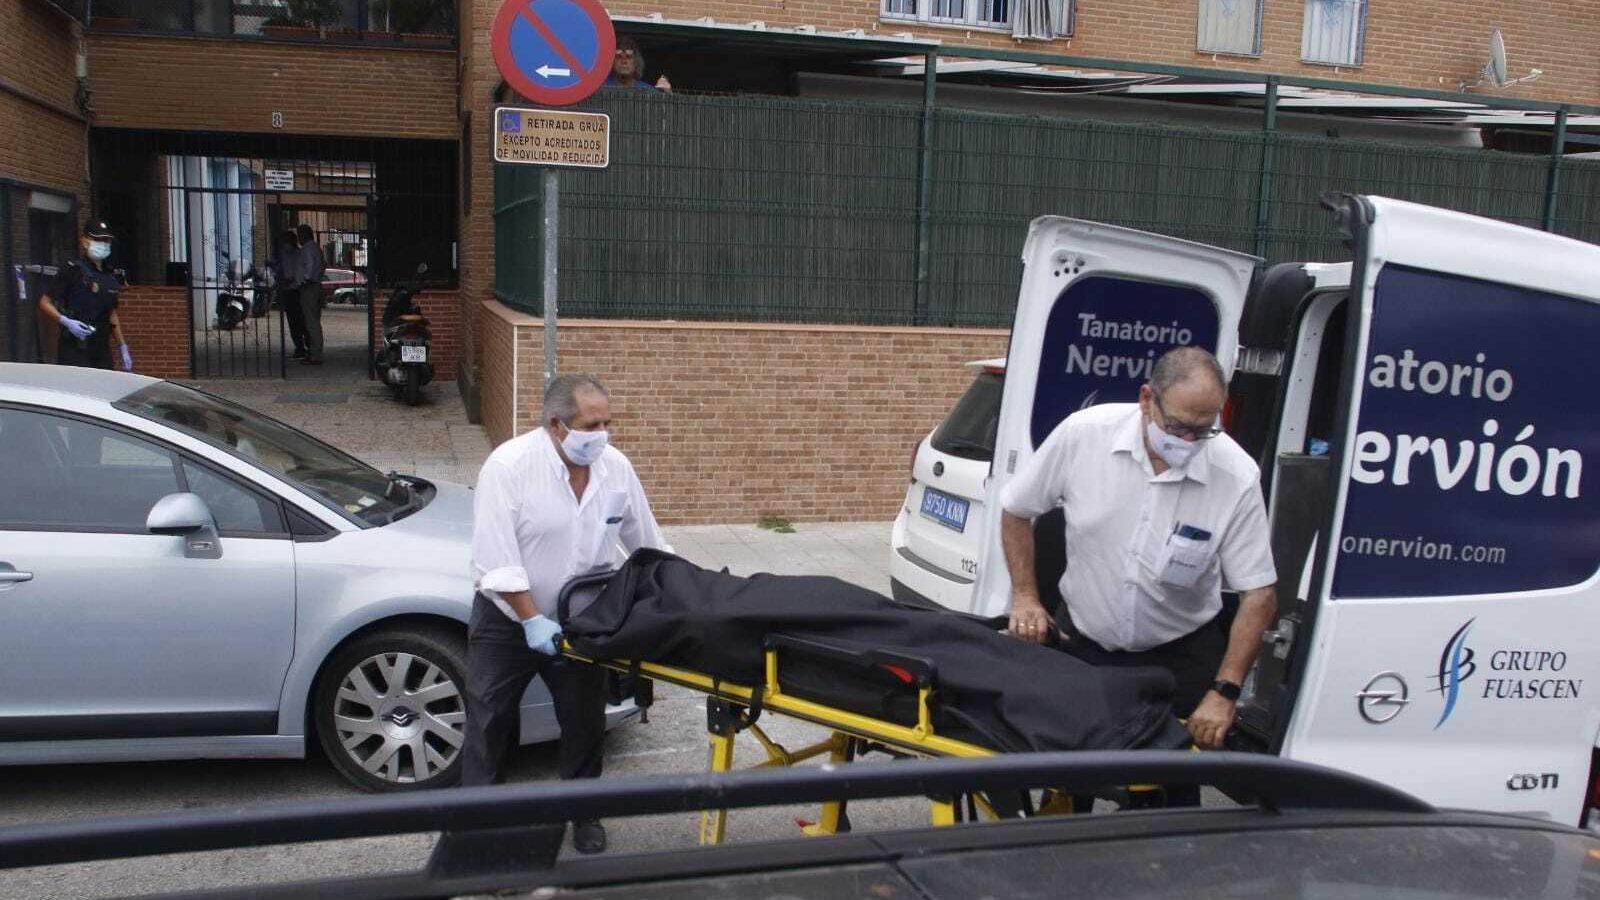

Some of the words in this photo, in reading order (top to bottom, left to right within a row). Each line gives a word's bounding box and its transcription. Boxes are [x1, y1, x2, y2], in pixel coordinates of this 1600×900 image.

[528, 118, 575, 130] RETIRADA
[503, 135, 541, 147] EXCEPTO
[545, 138, 601, 150] ACREDITADOS
[497, 148, 509, 159] DE
[513, 149, 559, 161] MOVILIDAD
[562, 152, 605, 164] REDUCIDA
[1078, 313, 1192, 346] Tanatorio
[1369, 349, 1514, 402] atorio
[1351, 418, 1583, 499] ervión
[925, 493, 947, 515] 9750
[946, 502, 967, 523] KNN
[961, 558, 978, 574] 1121
[1490, 650, 1567, 672] GRUPO
[1481, 679, 1583, 698] FUASCEN
